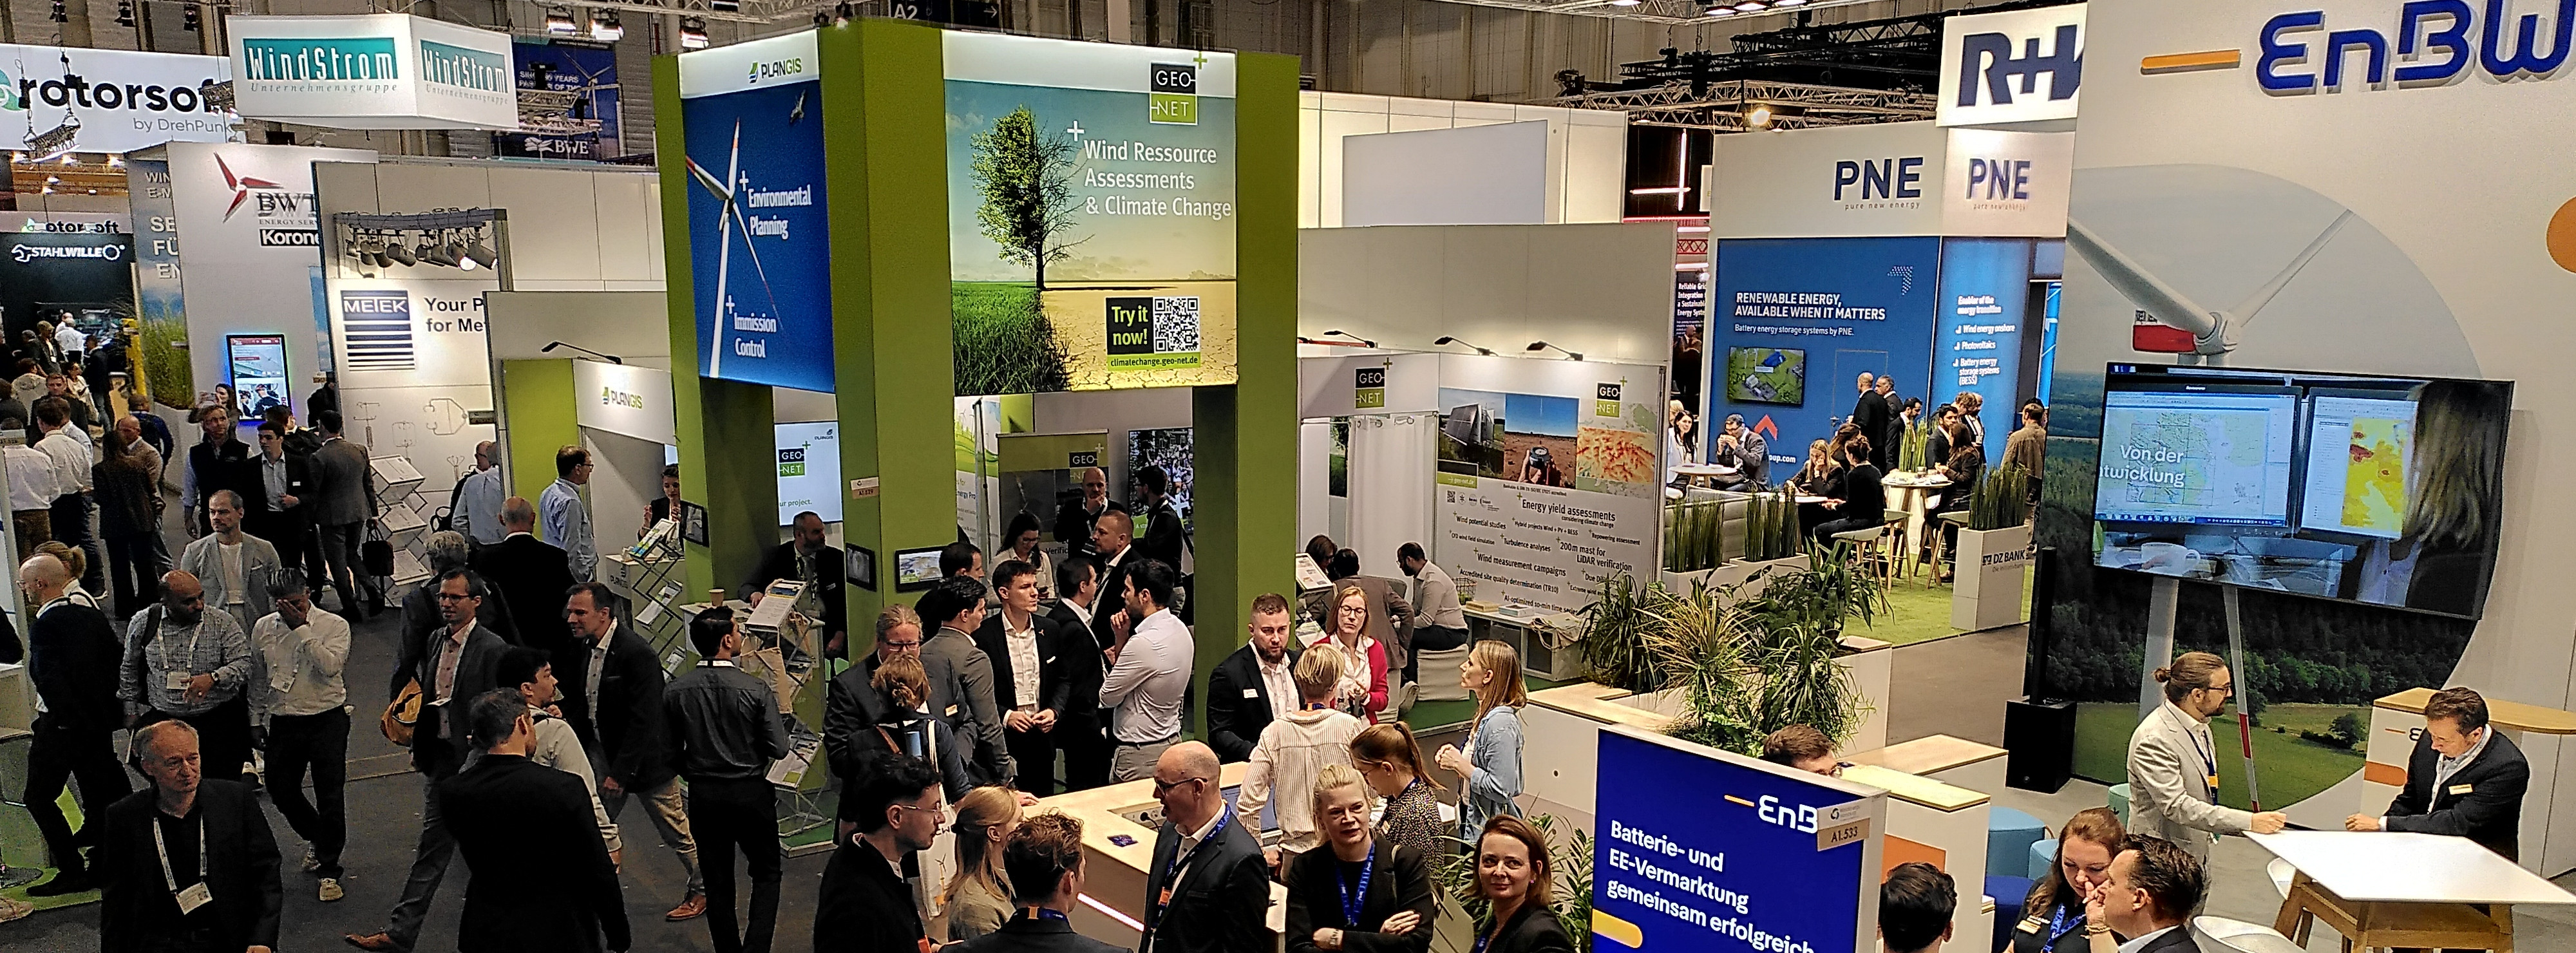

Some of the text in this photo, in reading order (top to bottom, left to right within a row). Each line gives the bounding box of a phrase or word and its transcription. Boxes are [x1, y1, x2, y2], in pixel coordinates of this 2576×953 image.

[893, 3, 918, 20] A2
[2255, 0, 2576, 90] EnBW
[247, 47, 395, 81] WindStrom
[423, 48, 508, 94] WindStrom
[761, 57, 802, 79] PLANGIS
[554, 75, 579, 84] YEARS
[18, 74, 214, 113] rotorsof
[251, 83, 397, 93] Unternehmensgruppe
[426, 84, 509, 106] Unternehmensgruppe
[133, 118, 233, 133] by DrehPunk
[555, 140, 589, 154] BWE
[1083, 140, 1217, 164] Wind Ressource
[1084, 168, 1195, 190] Assessments
[1833, 156, 1924, 201] PNE
[1966, 158, 2031, 201] PNE
[748, 185, 812, 208] Environmental
[1085, 195, 1231, 221] & Climate Change
[1845, 203, 1864, 211] pure
[1889, 201, 1920, 211] energy
[36, 220, 119, 233] otoroft
[750, 215, 789, 239] Planning
[32, 247, 102, 258] STAHLWILLE
[343, 298, 408, 314] METEK
[424, 297, 467, 312] Your
[1736, 292, 1842, 308] RENEWABLE ENERGY,
[1958, 296, 1994, 305] Enabler of the
[1111, 305, 1148, 327] Try it
[1677, 309, 1692, 317] Energy
[1735, 305, 1886, 320] AVAILABLE WHEN IT MATTERS
[1957, 305, 2002, 316] energy transition
[426, 318, 485, 332] for Me
[734, 312, 777, 333] Immission
[1735, 324, 1756, 334] Battery
[1757, 325, 1778, 334] energy
[1779, 326, 1802, 335] storage
[1803, 326, 1828, 335] systems
[1830, 327, 1837, 336] by
[1977, 326, 1994, 334] energy
[1995, 324, 2016, 332] onshore
[1113, 328, 1148, 346] now!
[735, 338, 766, 358] Control
[1962, 341, 1996, 350] Photovoltaics
[1110, 355, 1198, 367] climatechange.geo-net.de
[1960, 358, 1979, 367] Battery
[1979, 367, 2000, 376] systems
[611, 390, 643, 410] PLANGIS
[2120, 445, 2184, 463] Von der
[788, 498, 813, 508] project.
[1522, 499, 1616, 522] Energy yield assessments
[1456, 515, 1506, 529] Wind potential studies
[1561, 516, 1584, 525] considering
[1504, 538, 1551, 552] Turbulence analyses
[1591, 533, 1640, 545] Repowering assessment
[1560, 542, 1606, 556] 200m mast for
[1993, 549, 2025, 564] DZ BANK
[1477, 553, 1566, 577] Wind measurement campaigns
[1577, 554, 1633, 572] LiDAR verification
[1459, 569, 1483, 579] Accredited
[1493, 576, 1509, 585] quality
[1510, 578, 1542, 590] determination
[1542, 583, 1559, 594] (TR10)
[1585, 573, 1596, 582] Due
[1570, 585, 1586, 593] Extreme
[1504, 594, 1533, 607] AI-optimized
[1551, 604, 1563, 612] time
[1831, 826, 1858, 843] A1.533
[1611, 820, 1724, 873] Batterie- und
[1609, 848, 1749, 914] EE-Vermarktung
[1607, 880, 1707, 927] gemeinsam
